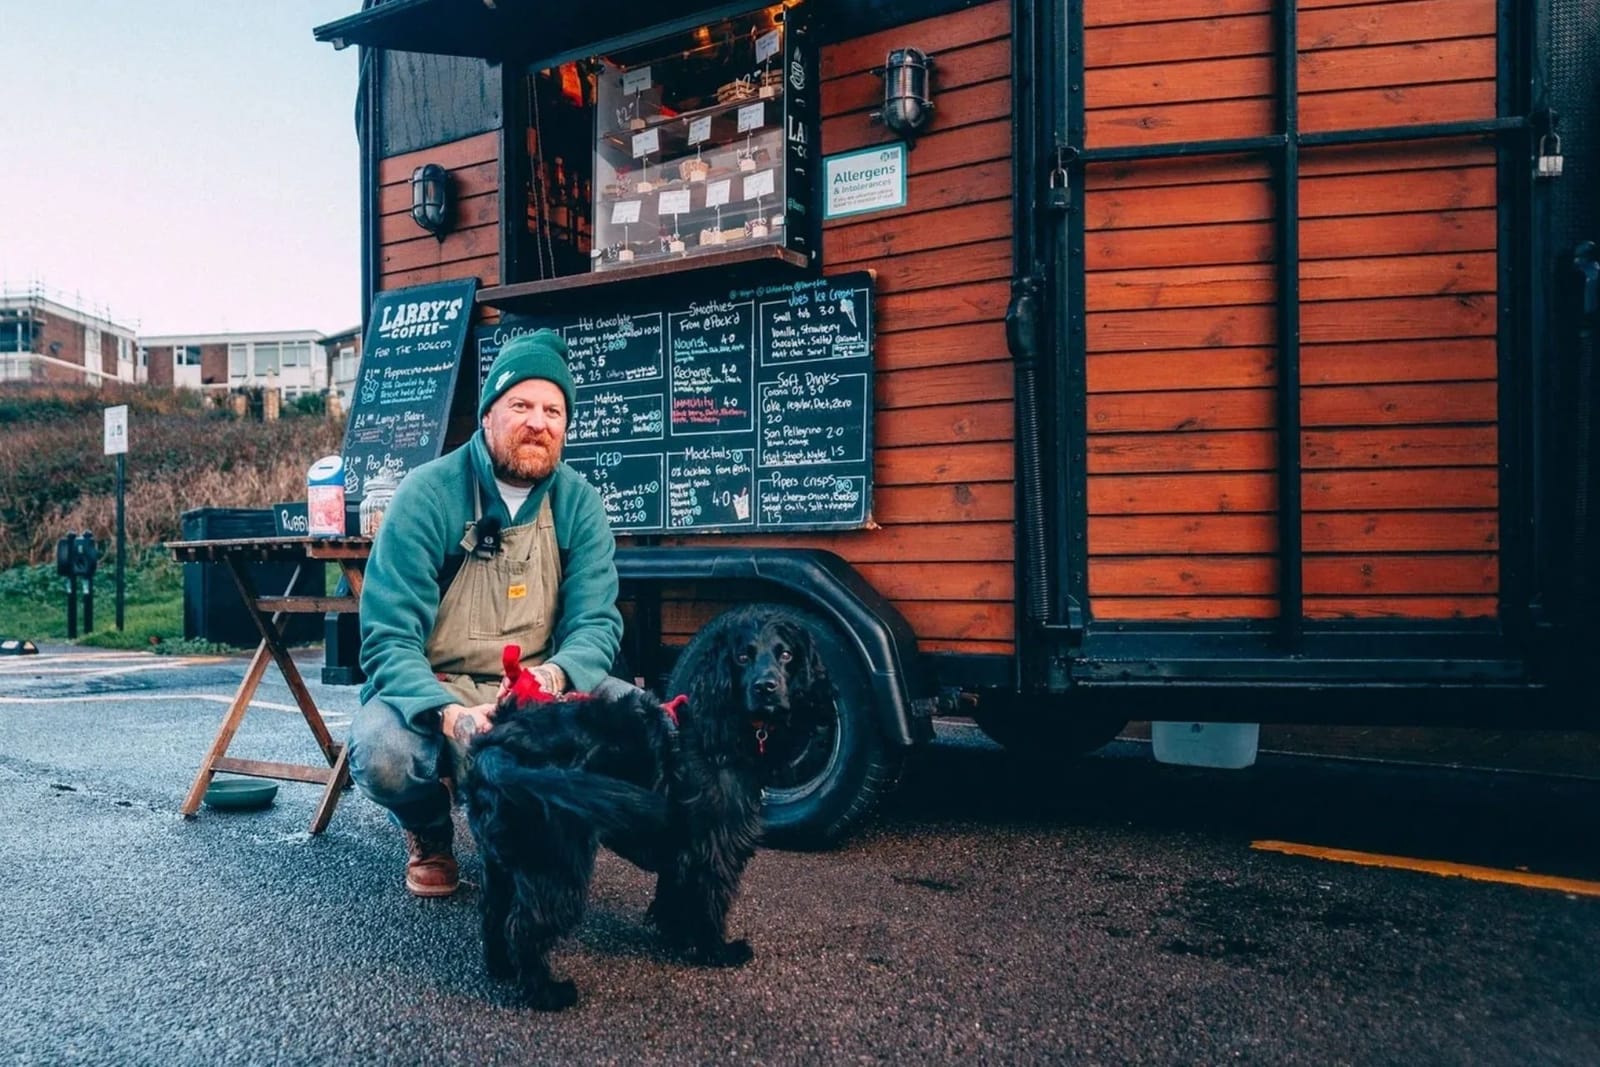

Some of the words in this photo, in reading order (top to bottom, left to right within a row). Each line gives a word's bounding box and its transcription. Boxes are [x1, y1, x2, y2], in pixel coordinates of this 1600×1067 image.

[833, 165, 896, 185] Allergens
[842, 179, 892, 194] Intolerances
[378, 297, 463, 332] LARRY'S
[689, 301, 735, 317] Smoothies
[391, 322, 439, 339] COFFEE
[579, 318, 594, 331] Hot
[396, 344, 412, 356] THE
[674, 337, 708, 349] Nourish
[673, 366, 712, 379] Recharge
[777, 372, 799, 388] Soft
[805, 372, 840, 386] Drinks
[594, 392, 624, 405] Matcha
[596, 451, 622, 467] ICED
[685, 446, 732, 460] Mocktails
[771, 471, 799, 490] Pipers
[281, 509, 309, 532] RUBBI
